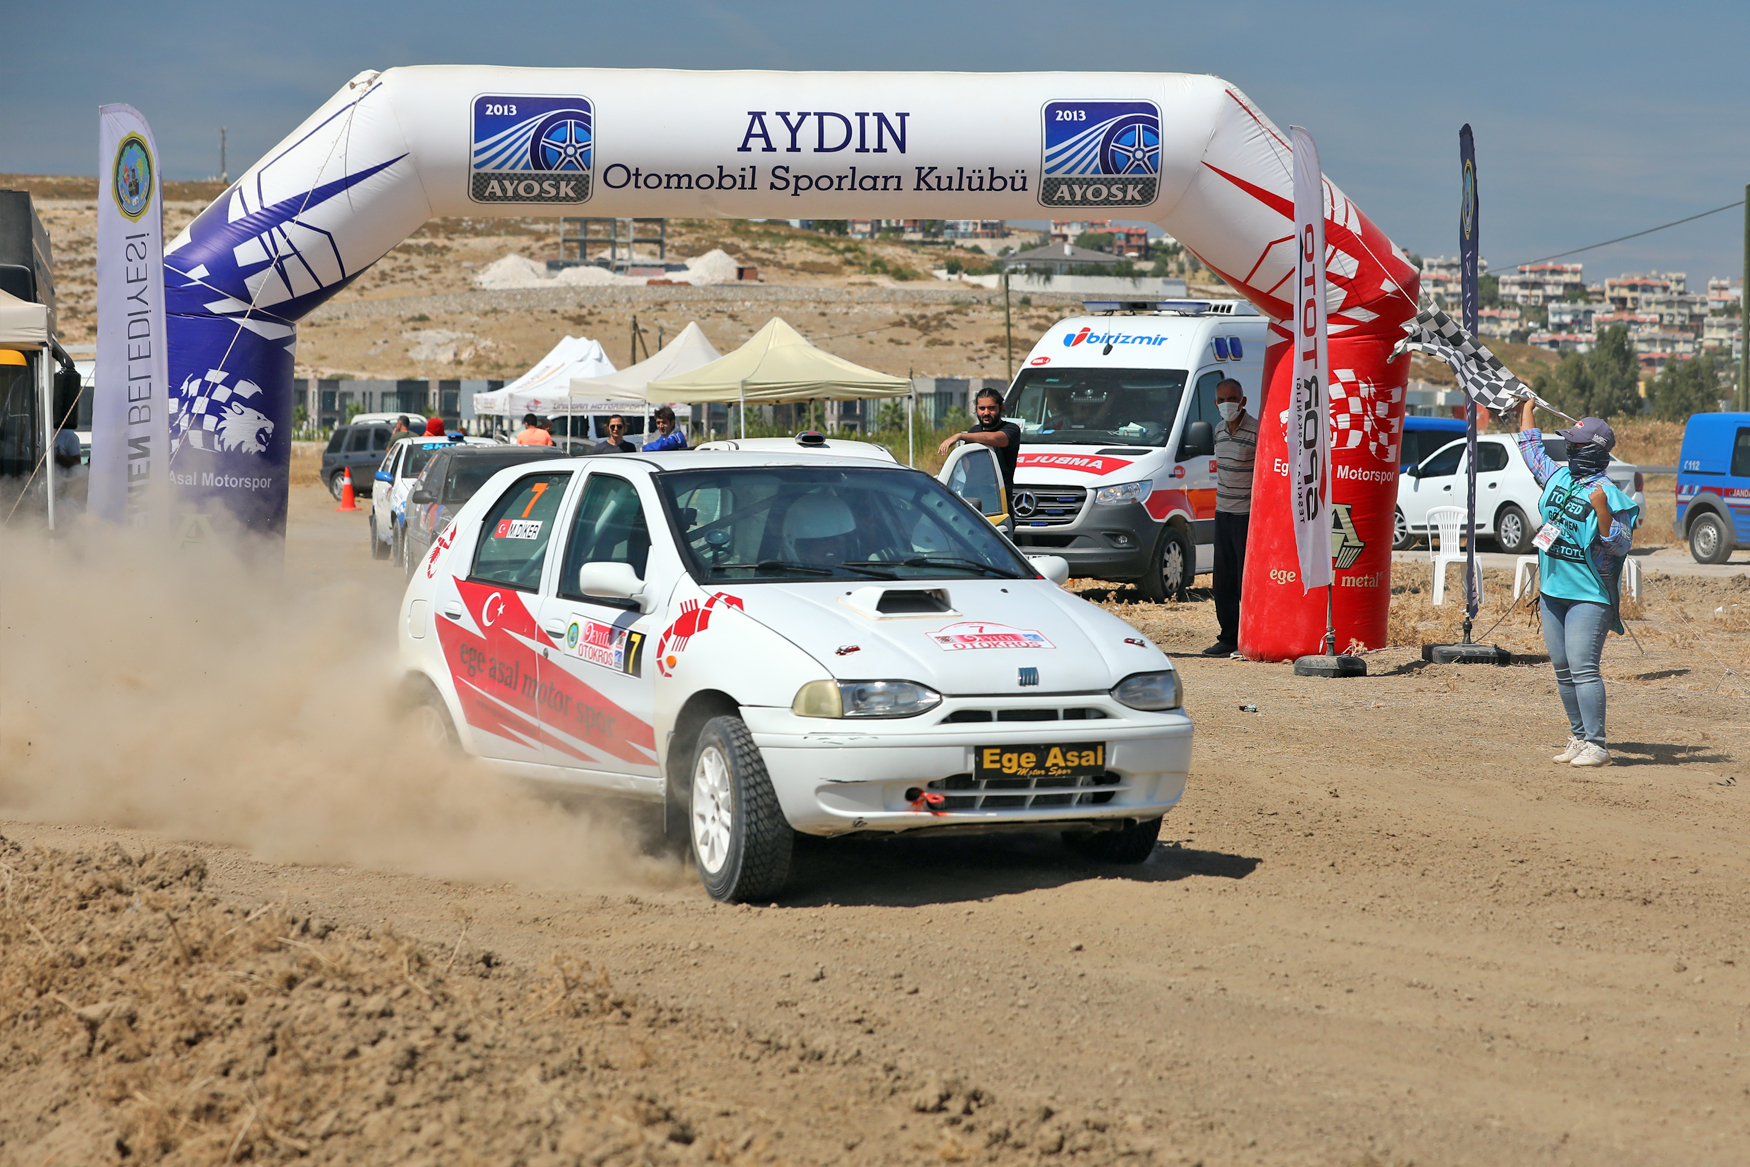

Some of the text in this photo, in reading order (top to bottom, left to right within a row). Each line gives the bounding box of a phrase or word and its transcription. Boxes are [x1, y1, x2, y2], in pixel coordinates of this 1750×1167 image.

[485, 104, 517, 116] 2013
[1055, 110, 1086, 121] 2013
[737, 111, 910, 154] AYDIN
[484, 180, 577, 198] AYOSK
[603, 163, 1028, 197] Otomobil Sporları Kulübü
[1052, 184, 1144, 201] AYOSK
[1086, 332, 1169, 346] birizmir
[1274, 458, 1290, 477] Eg
[1337, 465, 1394, 485] Motorspor
[1688, 460, 1700, 470] 112
[202, 472, 272, 491] Motorspor
[521, 482, 549, 518] 7
[1270, 569, 1296, 585] ege
[578, 643, 613, 666] OTOKROS
[628, 633, 642, 674] 7
[953, 641, 1042, 649] OTOKROS
[460, 642, 486, 677] ege
[489, 657, 519, 691] asal
[521, 673, 573, 717] motor
[576, 700, 616, 737] spor
[983, 745, 1103, 774] Ege Asal
